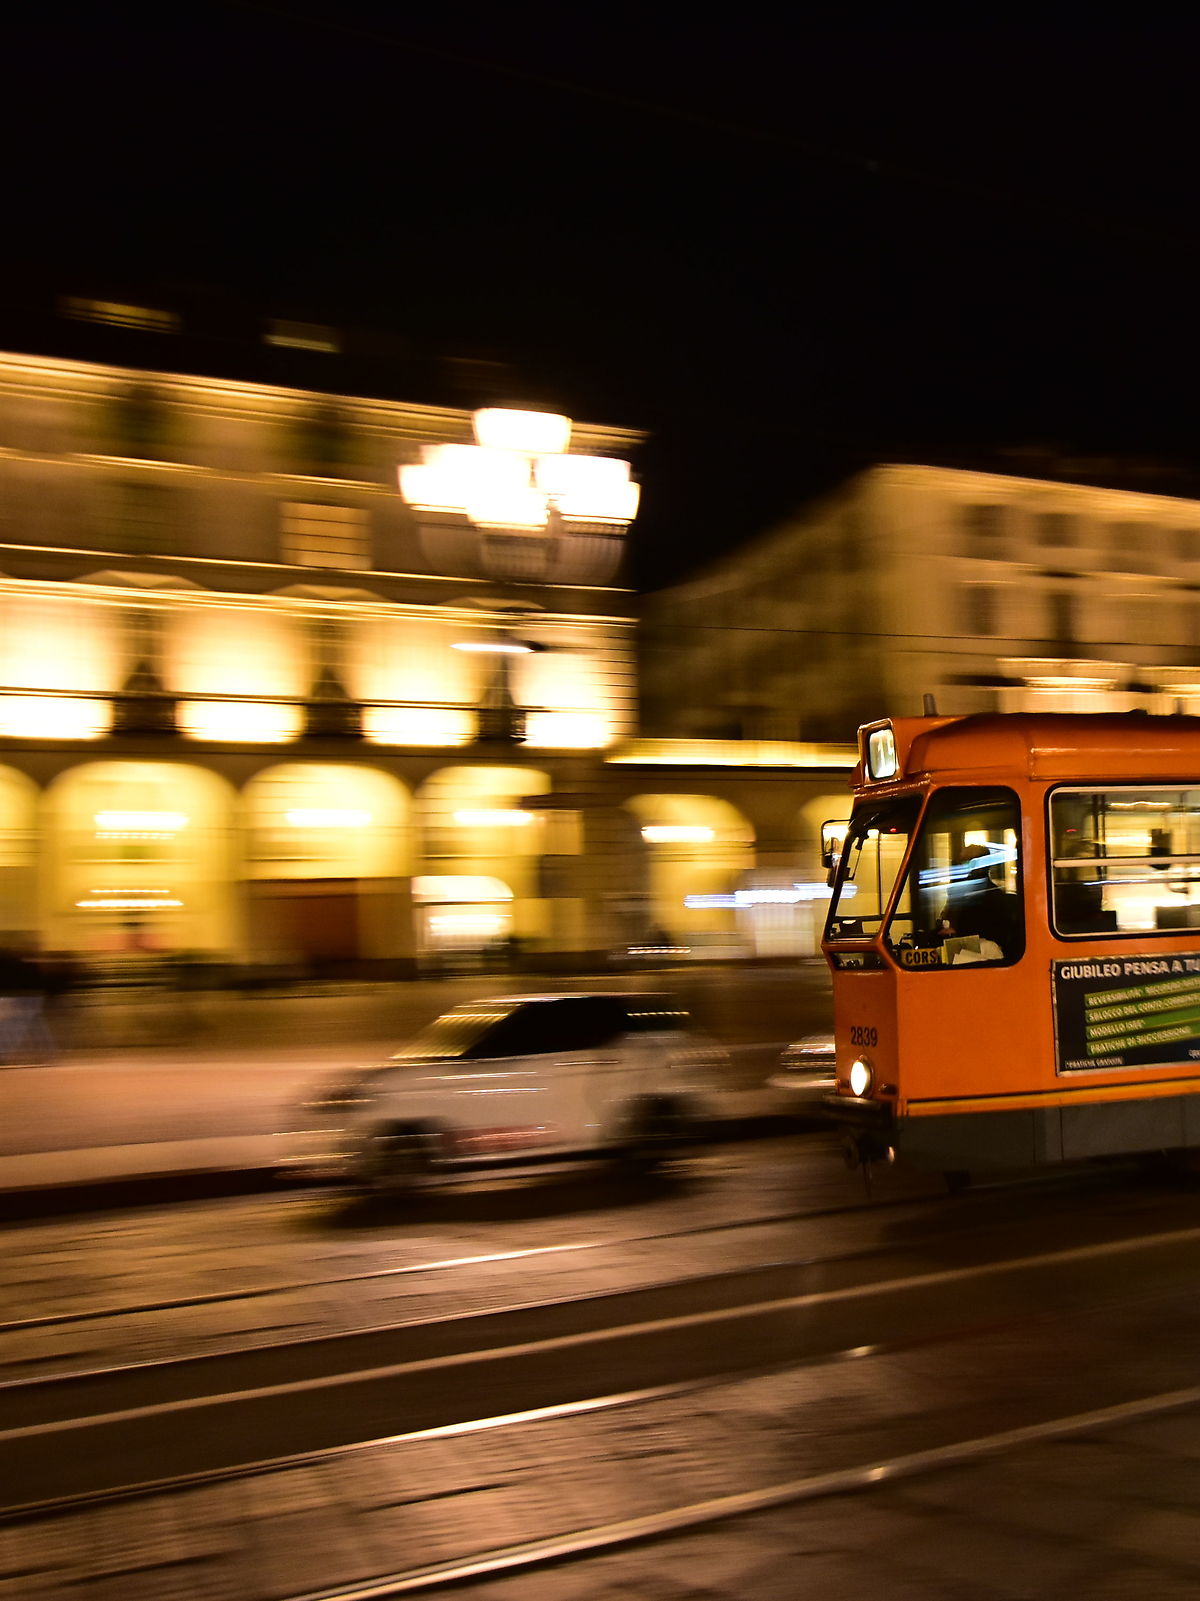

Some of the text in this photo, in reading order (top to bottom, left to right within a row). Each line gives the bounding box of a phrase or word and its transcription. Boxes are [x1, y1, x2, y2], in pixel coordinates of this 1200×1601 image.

[1061, 963, 1122, 980] GIUBILEO
[1124, 961, 1169, 976] PENSA
[1172, 960, 1184, 973] A
[851, 1026, 878, 1047] 2839
[1090, 1023, 1123, 1038] MODELLO
